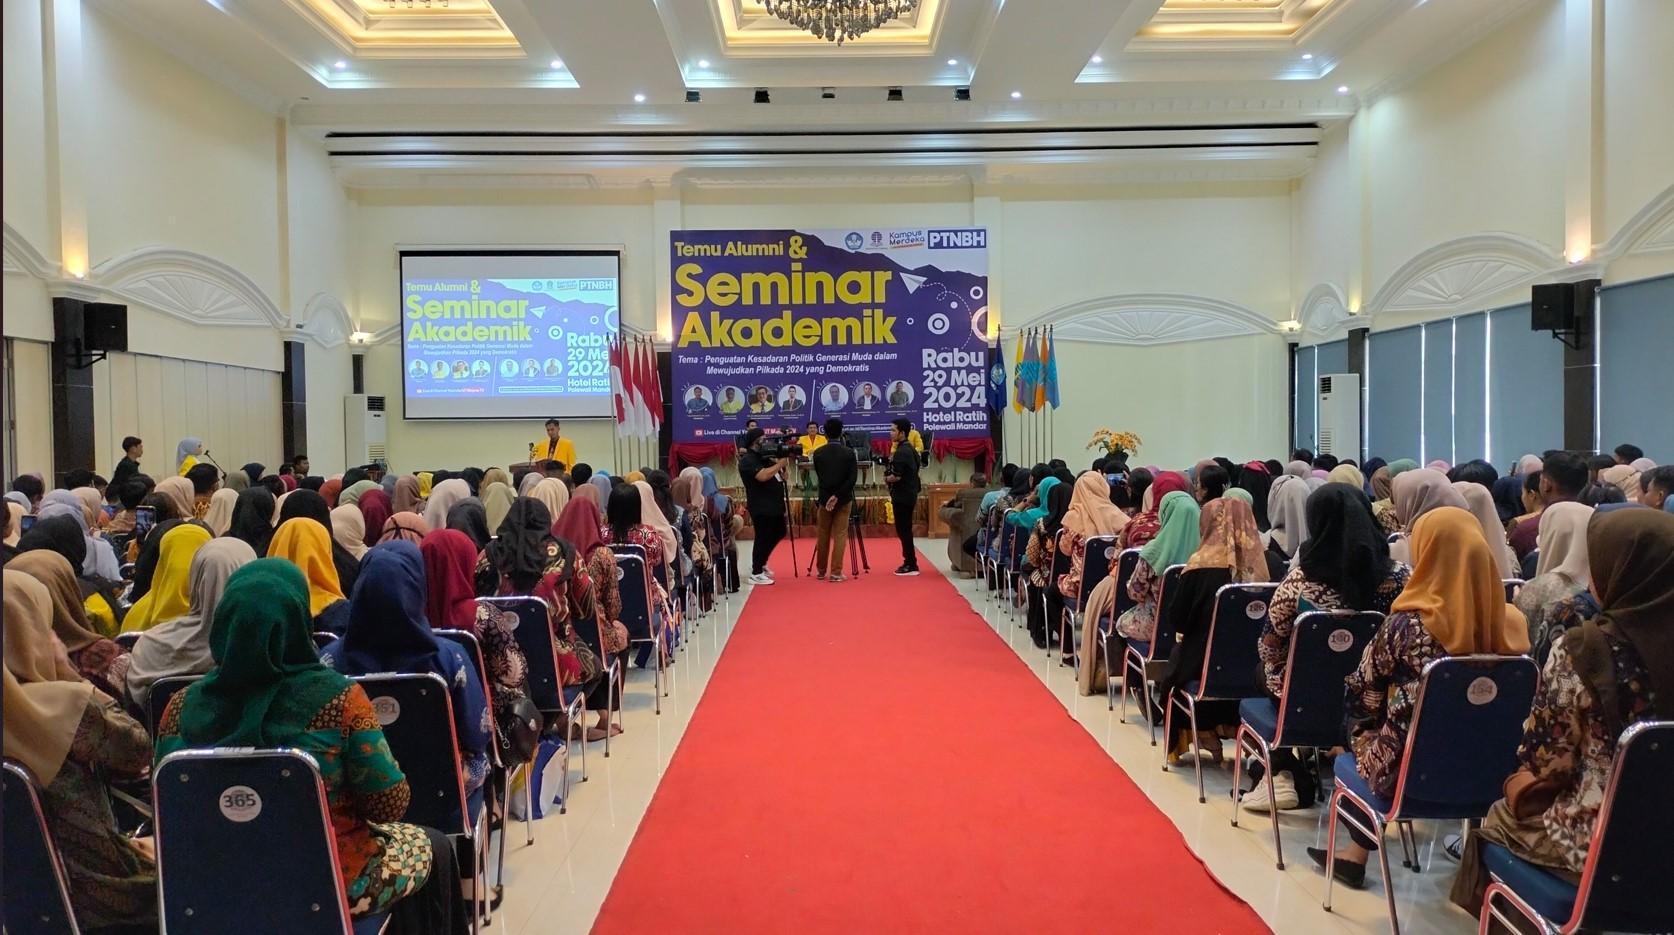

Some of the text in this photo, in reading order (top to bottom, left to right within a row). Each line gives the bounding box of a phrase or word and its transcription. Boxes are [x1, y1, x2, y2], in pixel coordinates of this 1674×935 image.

[889, 230, 922, 240] Kampus
[889, 236, 925, 246] Merdeka
[929, 231, 985, 247] PTNBH
[674, 235, 808, 259] Temu Alumni &
[406, 279, 481, 294] Temu Alumni &
[580, 280, 613, 291] PTNBH
[675, 262, 893, 307] Seminar
[406, 294, 529, 320] Seminar
[407, 320, 532, 342] Akademik
[677, 308, 898, 348] Akademik
[567, 348, 609, 361] 29 Me
[678, 355, 698, 364] Tema
[704, 354, 746, 365] Penguatan
[747, 354, 788, 363] Kesadaran
[789, 353, 814, 362] Politik
[815, 353, 850, 362] Generasi
[851, 352, 872, 361] Muda
[874, 351, 898, 360] dalam
[922, 348, 985, 368] Rabu
[706, 363, 870, 376] Mewujudkan Pilkada 2024 yang Demokratis
[568, 378, 610, 387] Hotel Rati
[922, 369, 985, 386] 29 Mei
[923, 386, 987, 408] 2024
[923, 411, 955, 422] Hotel
[956, 410, 987, 422] Ratih
[923, 422, 987, 431] Polewali Mandar
[223, 793, 256, 808] 365
